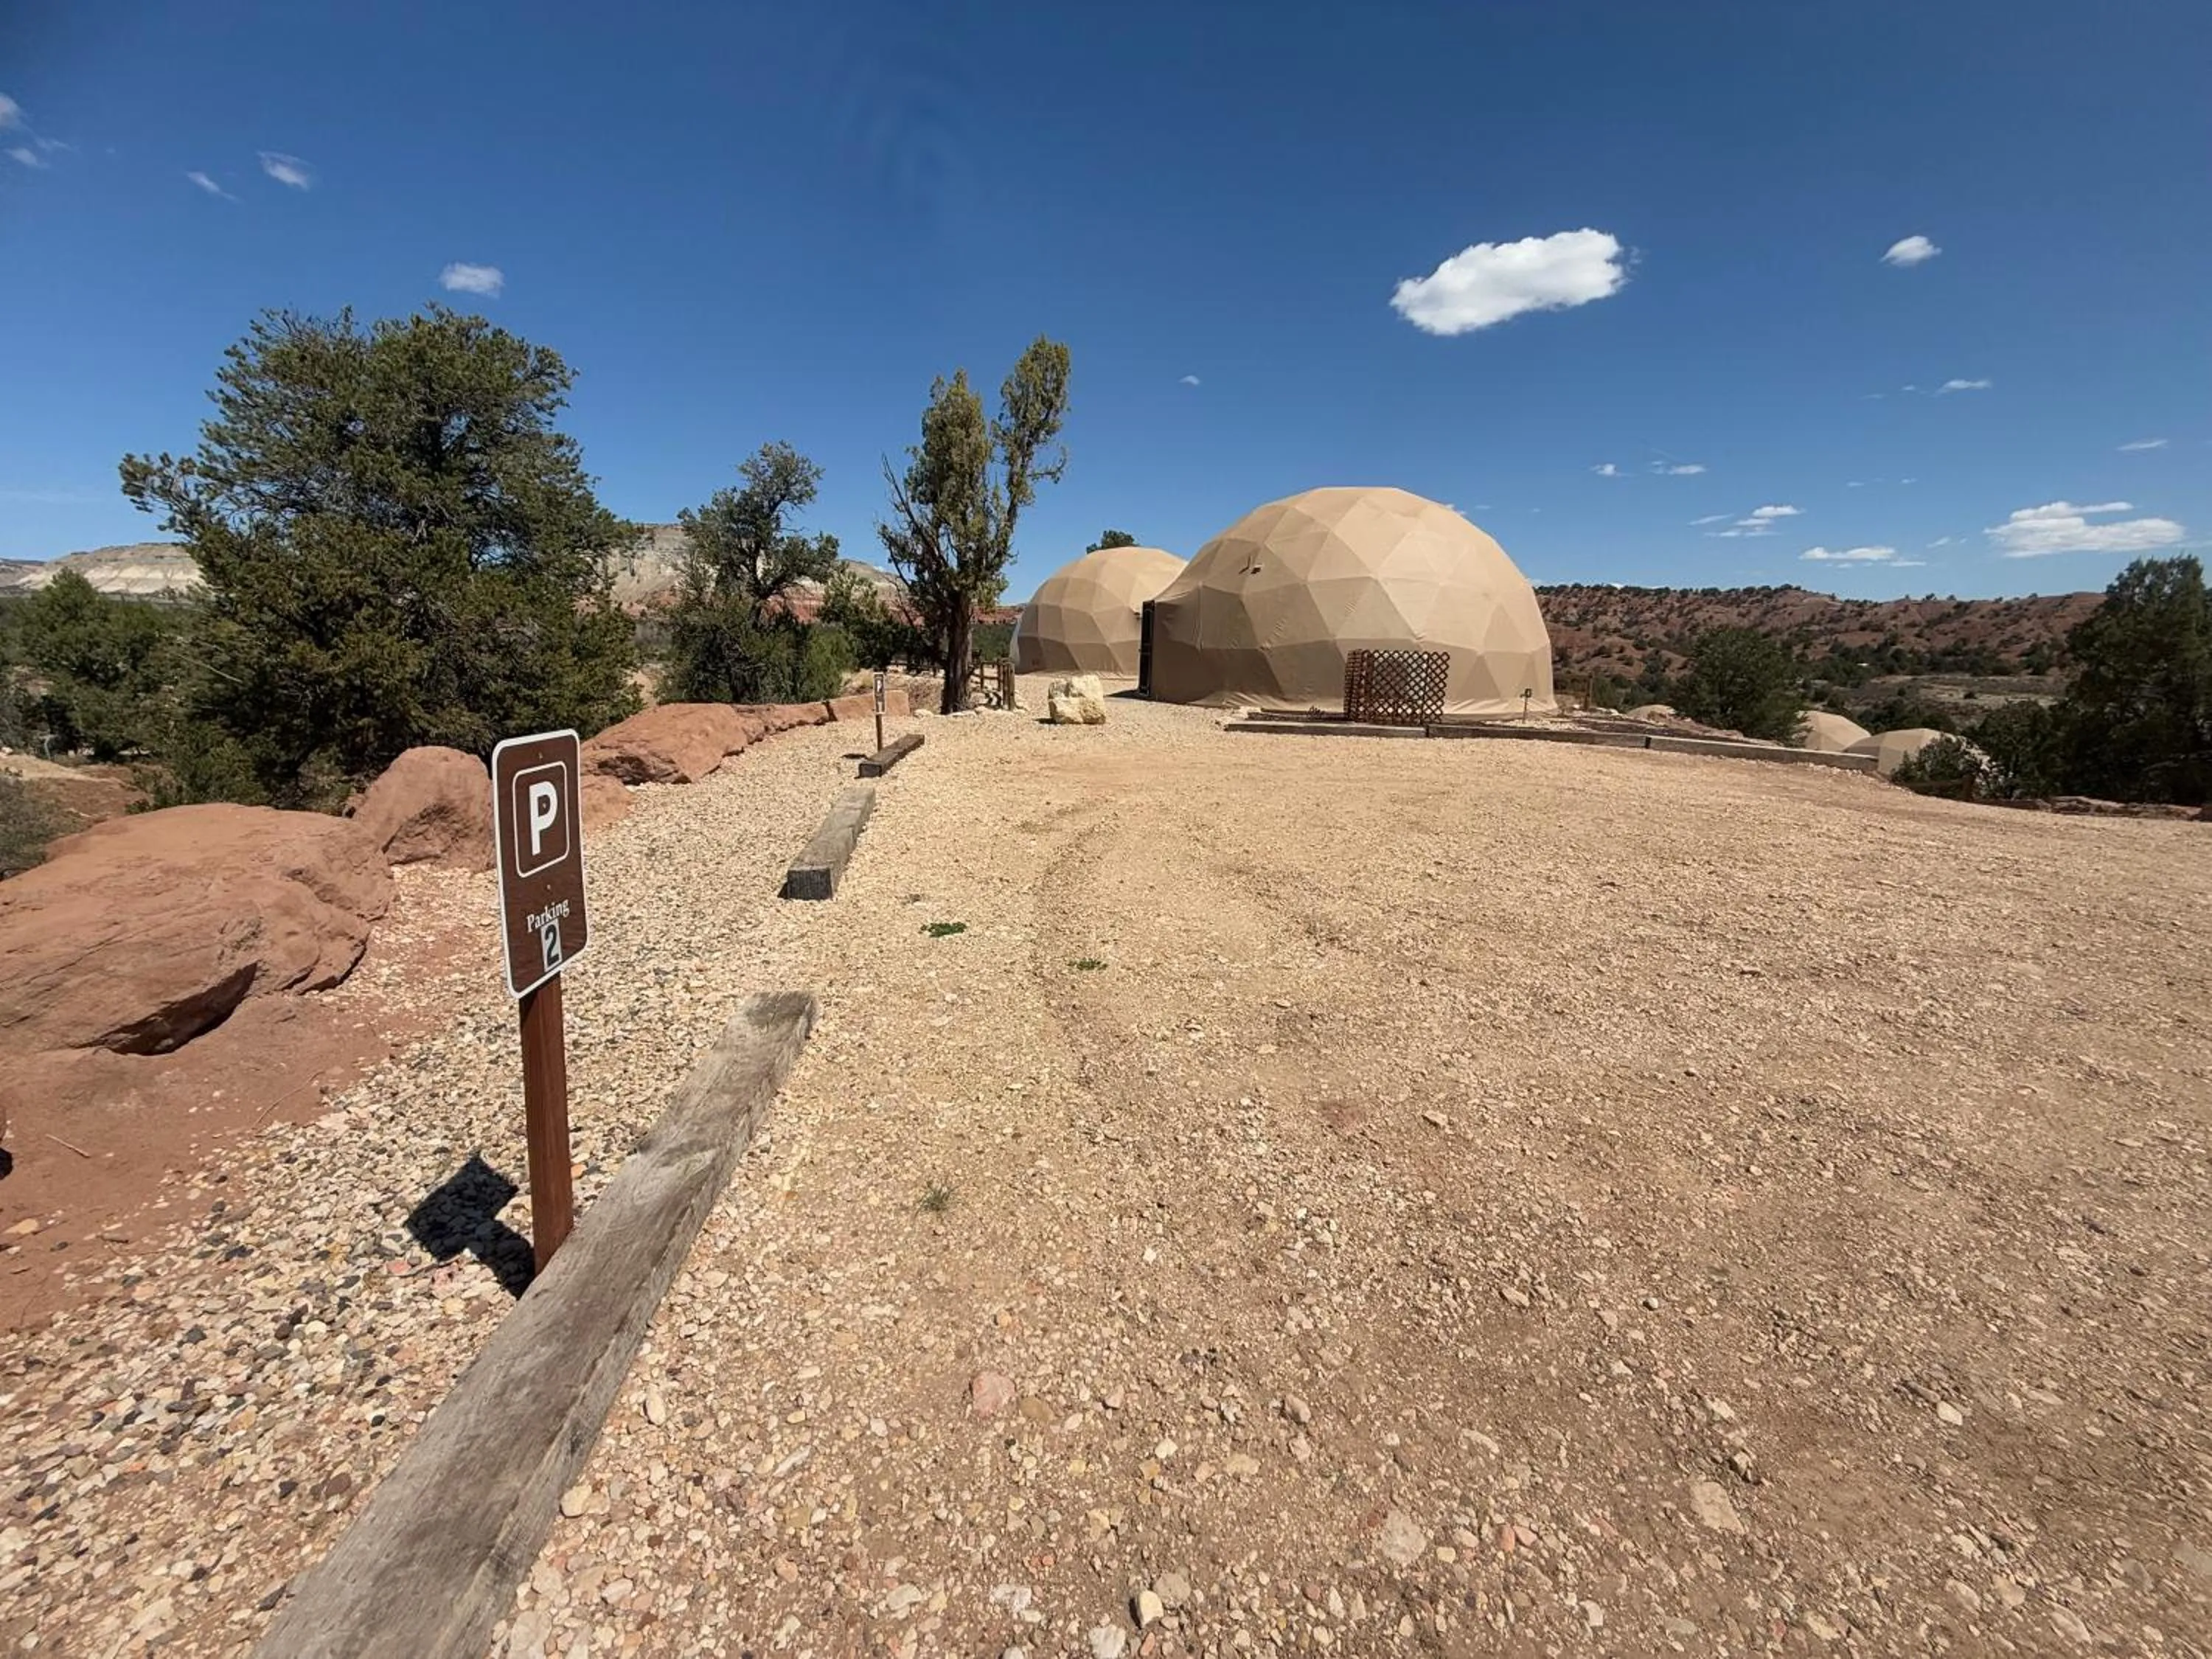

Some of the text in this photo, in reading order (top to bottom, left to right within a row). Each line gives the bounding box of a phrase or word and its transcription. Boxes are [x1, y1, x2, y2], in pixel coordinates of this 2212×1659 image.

[529, 781, 558, 856] P
[526, 900, 570, 933] Parking
[545, 925, 560, 966] 2
